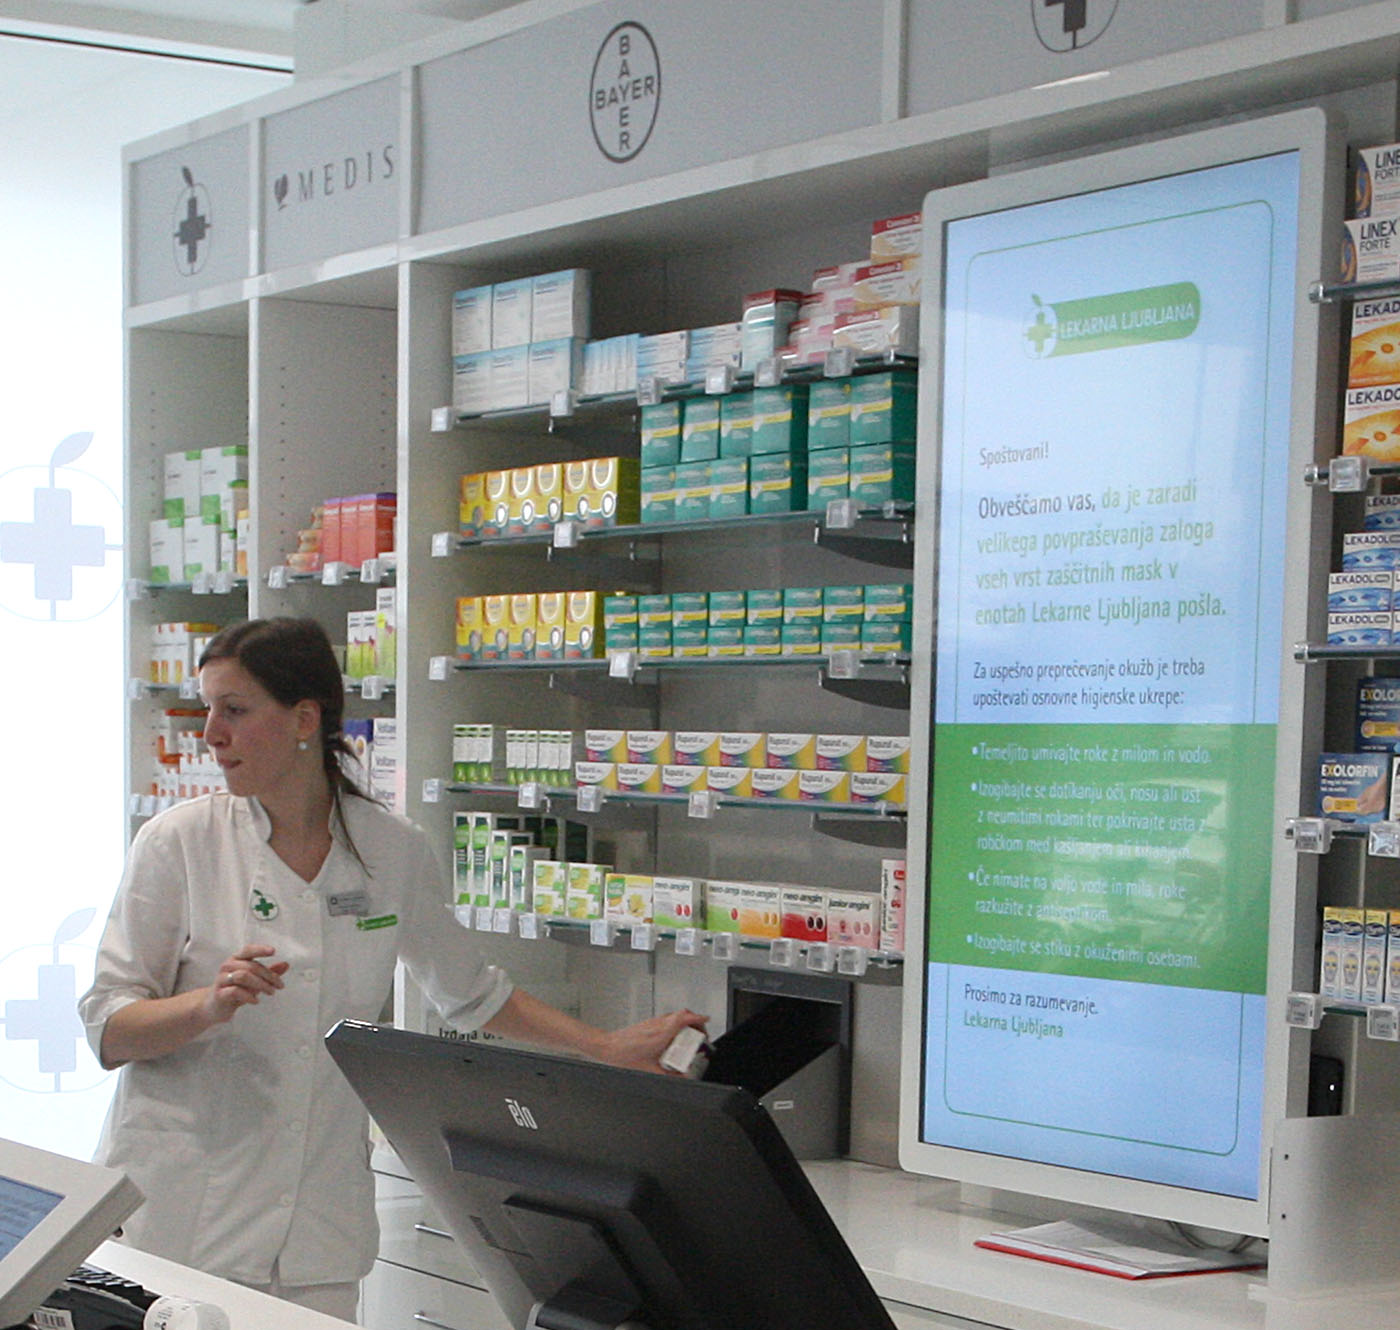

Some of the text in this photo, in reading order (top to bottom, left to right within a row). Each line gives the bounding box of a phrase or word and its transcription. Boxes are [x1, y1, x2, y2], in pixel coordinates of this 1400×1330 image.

[595, 75, 655, 110] BAYER
[618, 34, 631, 152] BAYER
[297, 145, 394, 201] MEDIS
[1060, 302, 1196, 340] LEKARNA LJUBLJANA
[979, 441, 1050, 469] Spoštovani!
[978, 478, 1197, 520] Obveščamo vas, da je zaradi
[977, 518, 1215, 558] velikega povpraševanja zaloga
[976, 558, 1179, 590] vseh vrst zaščitnih mask v
[975, 592, 1227, 627] enotah Lekarne Ljubljana pošla.
[973, 656, 1205, 682] Za uspešno preprečevanje okužb je treba
[973, 688, 1185, 709] upoštevati osnovne higienske ukrepe:
[979, 741, 1030, 764] Temeljito
[1031, 744, 1082, 765] umivajte
[1084, 744, 1107, 762] roke
[1111, 748, 1119, 762] z
[1121, 744, 1160, 763] milom
[1163, 745, 1175, 763] in
[1321, 764, 1379, 778] EXOLORFIN
[979, 780, 1032, 801] Izogibajte
[1034, 785, 1047, 799] se
[1049, 783, 1101, 803] dotikanju
[1130, 786, 1159, 801] nosu
[1162, 786, 1178, 801] ali
[1169, 815, 1196, 832] usta
[1026, 836, 1050, 852] med
[975, 866, 991, 886] Če
[993, 872, 1031, 890] nimate
[1033, 876, 1047, 891] na
[1158, 881, 1187, 899] roke
[974, 931, 1027, 956] Izogibajte
[1030, 940, 1042, 955] se
[1043, 938, 1072, 957] stiku
[964, 983, 1100, 1018] Prosimo za razumevanje.
[963, 1009, 1064, 1041] Lekarna Ljubljana
